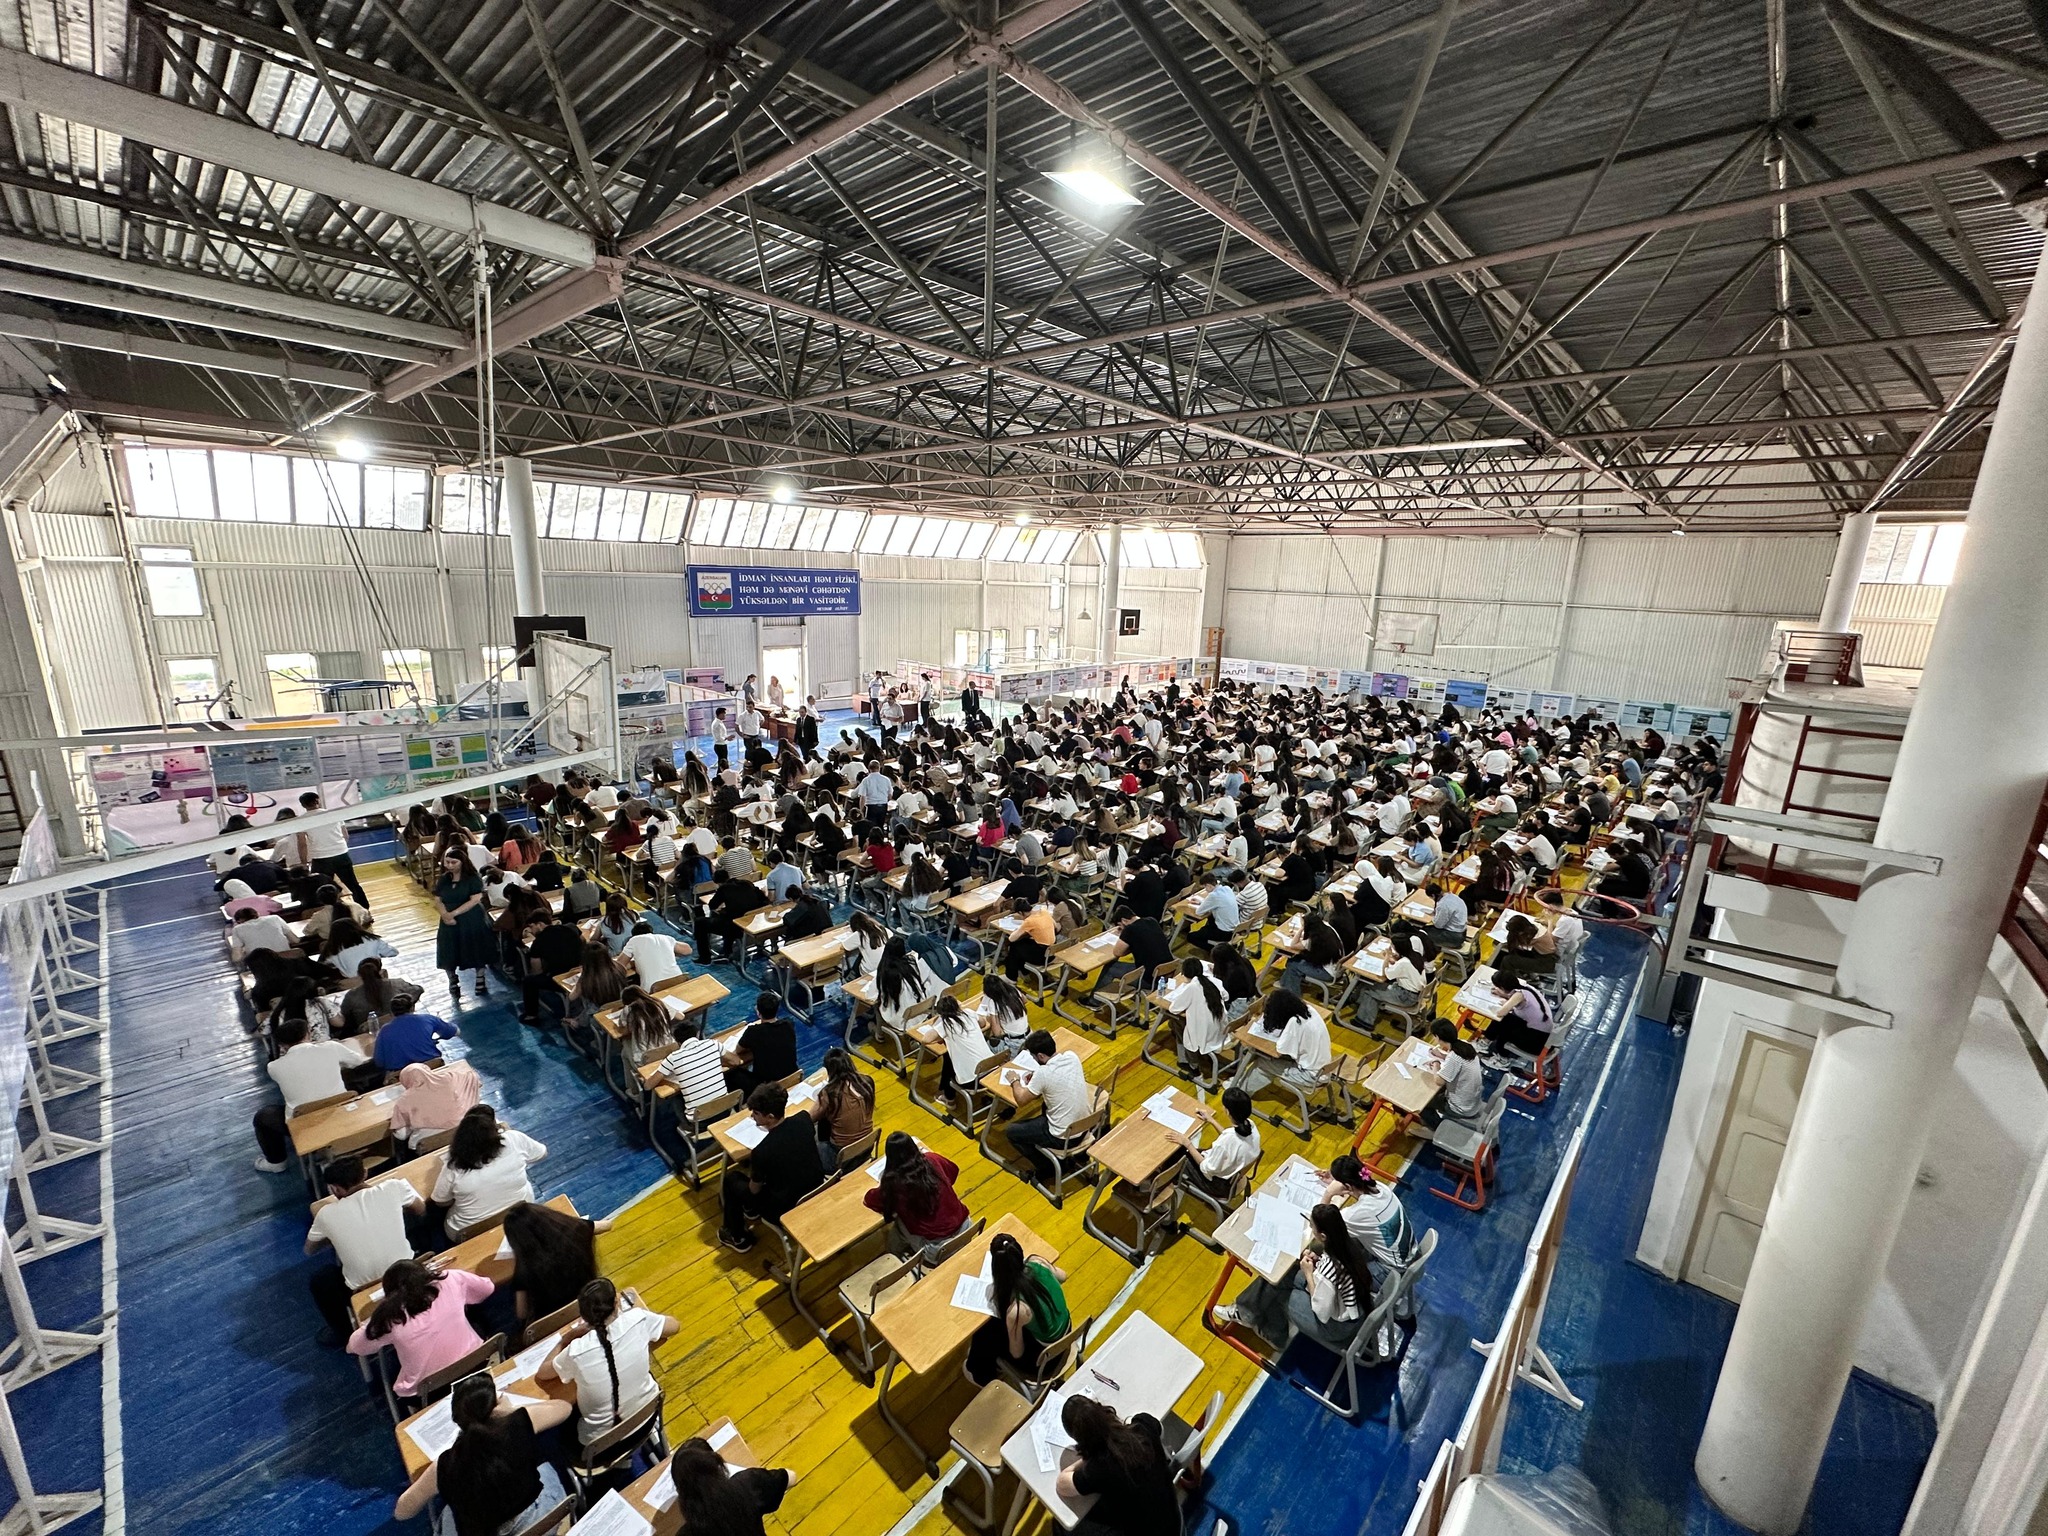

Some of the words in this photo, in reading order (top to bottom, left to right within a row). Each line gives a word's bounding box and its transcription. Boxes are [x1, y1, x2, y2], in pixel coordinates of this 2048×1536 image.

[738, 572, 767, 582] İDMAN
[770, 573, 811, 583] İNSANLARI
[815, 576, 832, 584] HƏM
[739, 586, 759, 594] HƏM
[779, 585, 809, 594] MƏNƏVİ
[739, 595, 788, 605] YÜKSƏLDƏN
[792, 596, 805, 605] BİR
